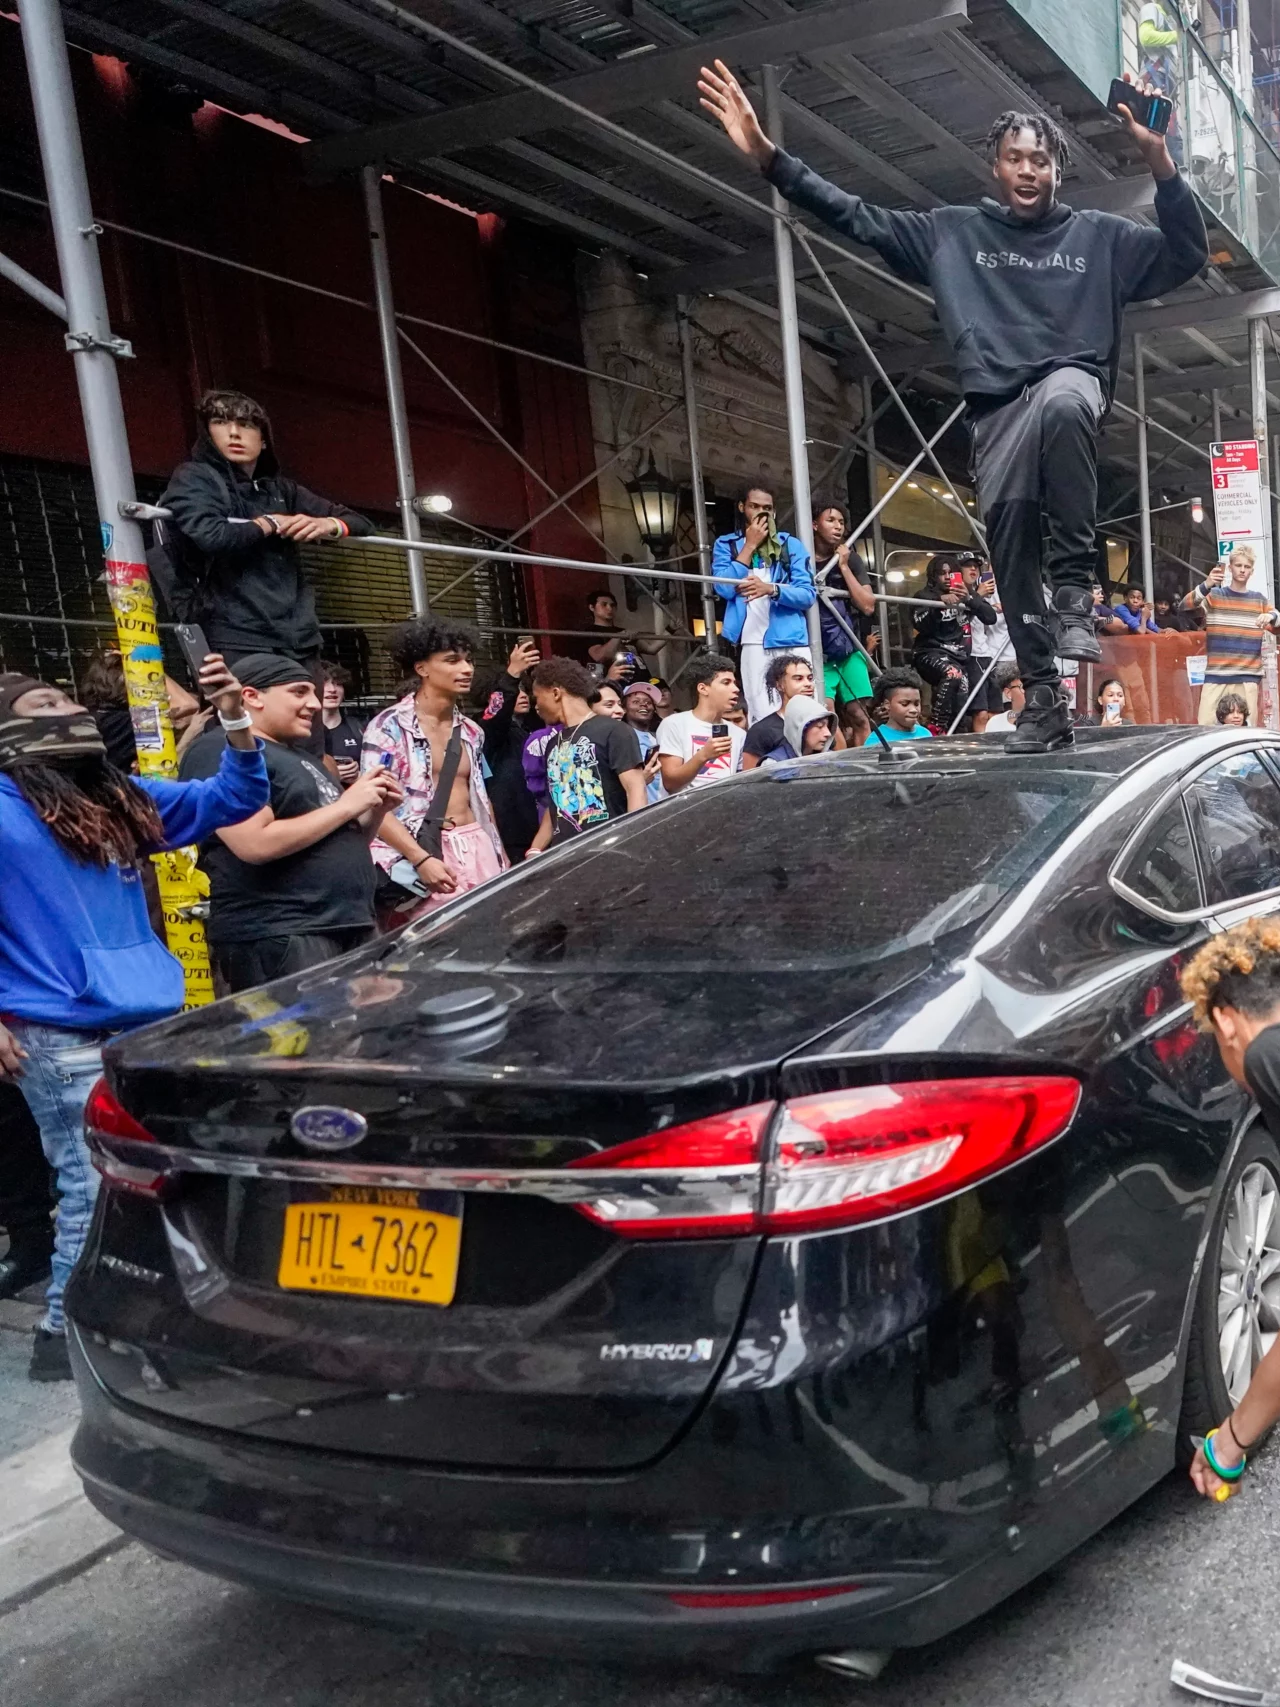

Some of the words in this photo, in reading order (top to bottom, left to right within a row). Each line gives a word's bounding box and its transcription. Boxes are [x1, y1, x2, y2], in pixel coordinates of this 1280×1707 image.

[1217, 475, 1226, 488] 3
[1216, 492, 1252, 500] COMMERCIAL
[1218, 499, 1243, 507] VEHICLES
[1222, 543, 1230, 555] 2
[376, 1188, 420, 1209] YORK
[296, 1211, 345, 1270] HTL
[371, 1215, 438, 1279] 7362
[320, 1272, 368, 1291] EMPIRE
[372, 1279, 410, 1296] STATE
[600, 1343, 692, 1361] HYBRID
